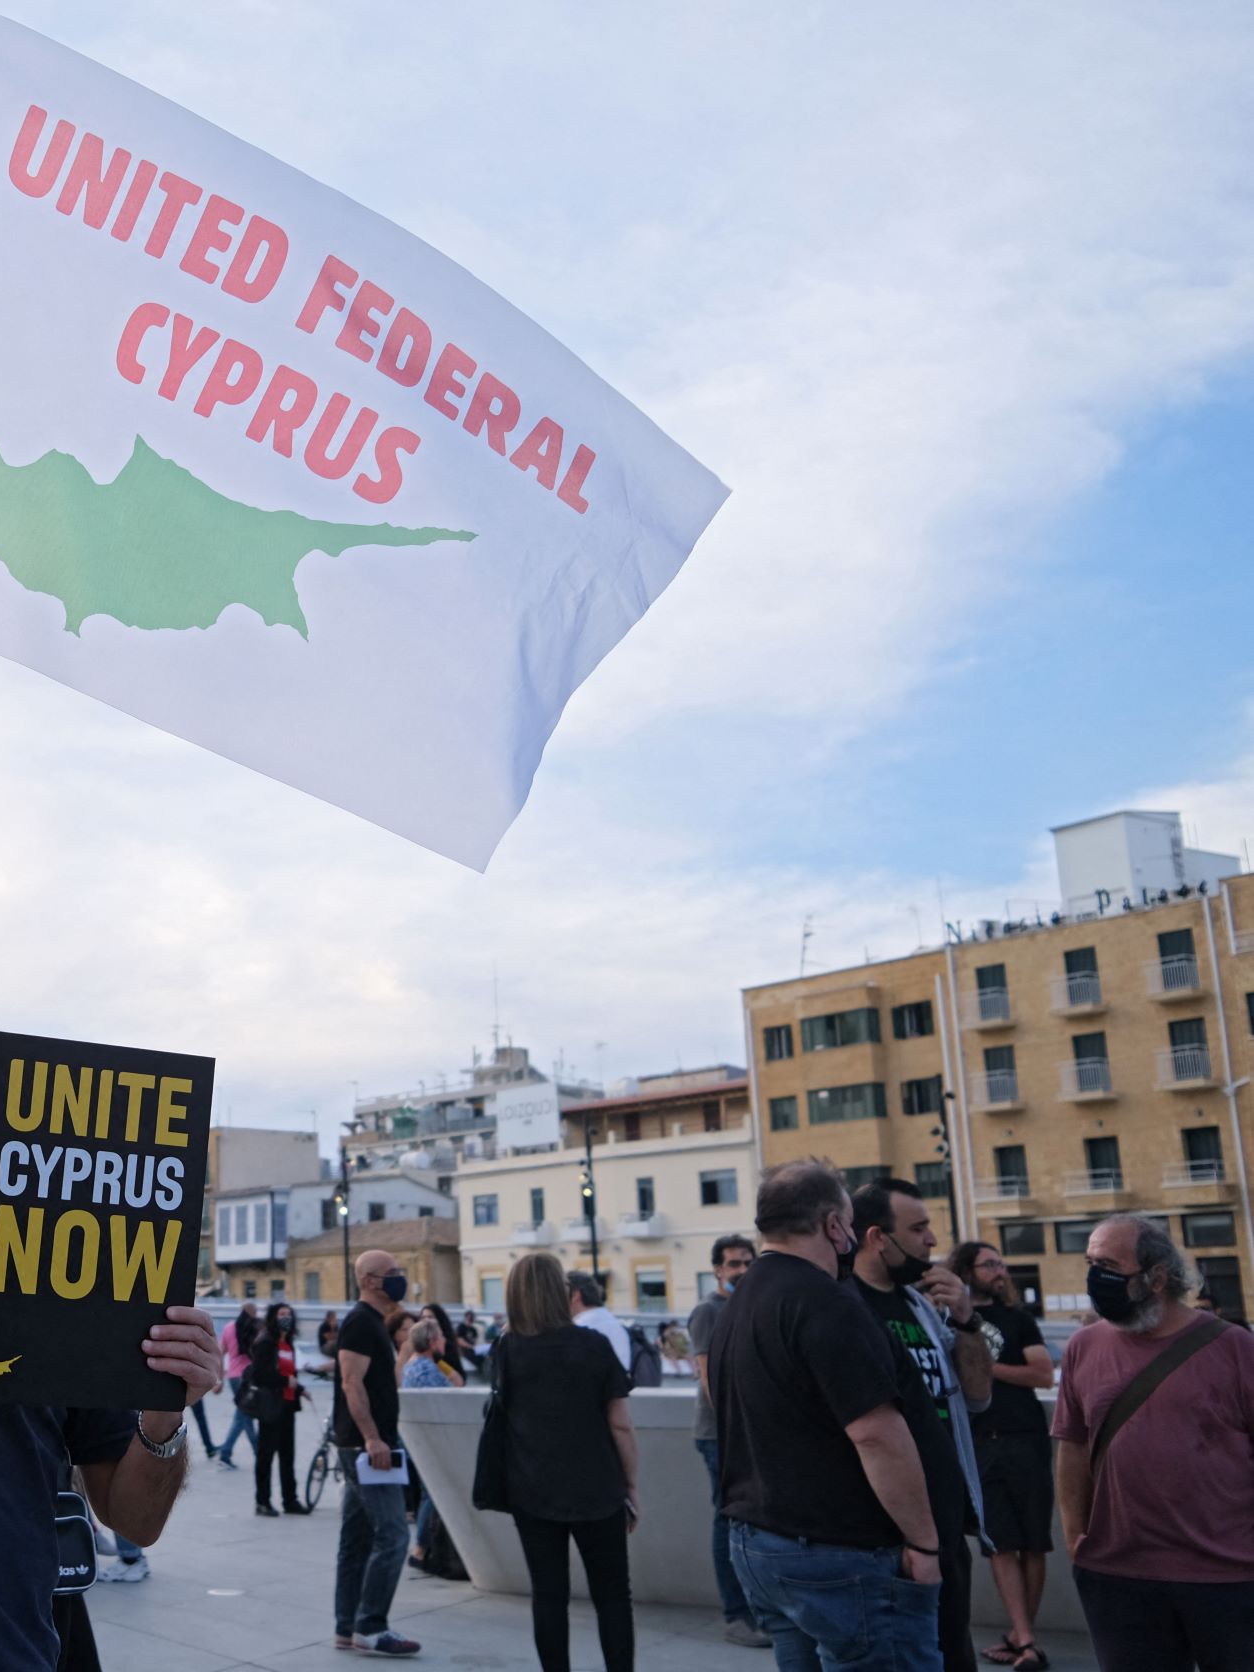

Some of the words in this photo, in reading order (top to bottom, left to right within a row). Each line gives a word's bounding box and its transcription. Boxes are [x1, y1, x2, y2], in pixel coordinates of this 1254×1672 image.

[8, 105, 290, 303] UNITED
[296, 255, 596, 514] FEDERAL
[116, 303, 421, 504] CYPRUS
[6, 1059, 192, 1146] UNITE
